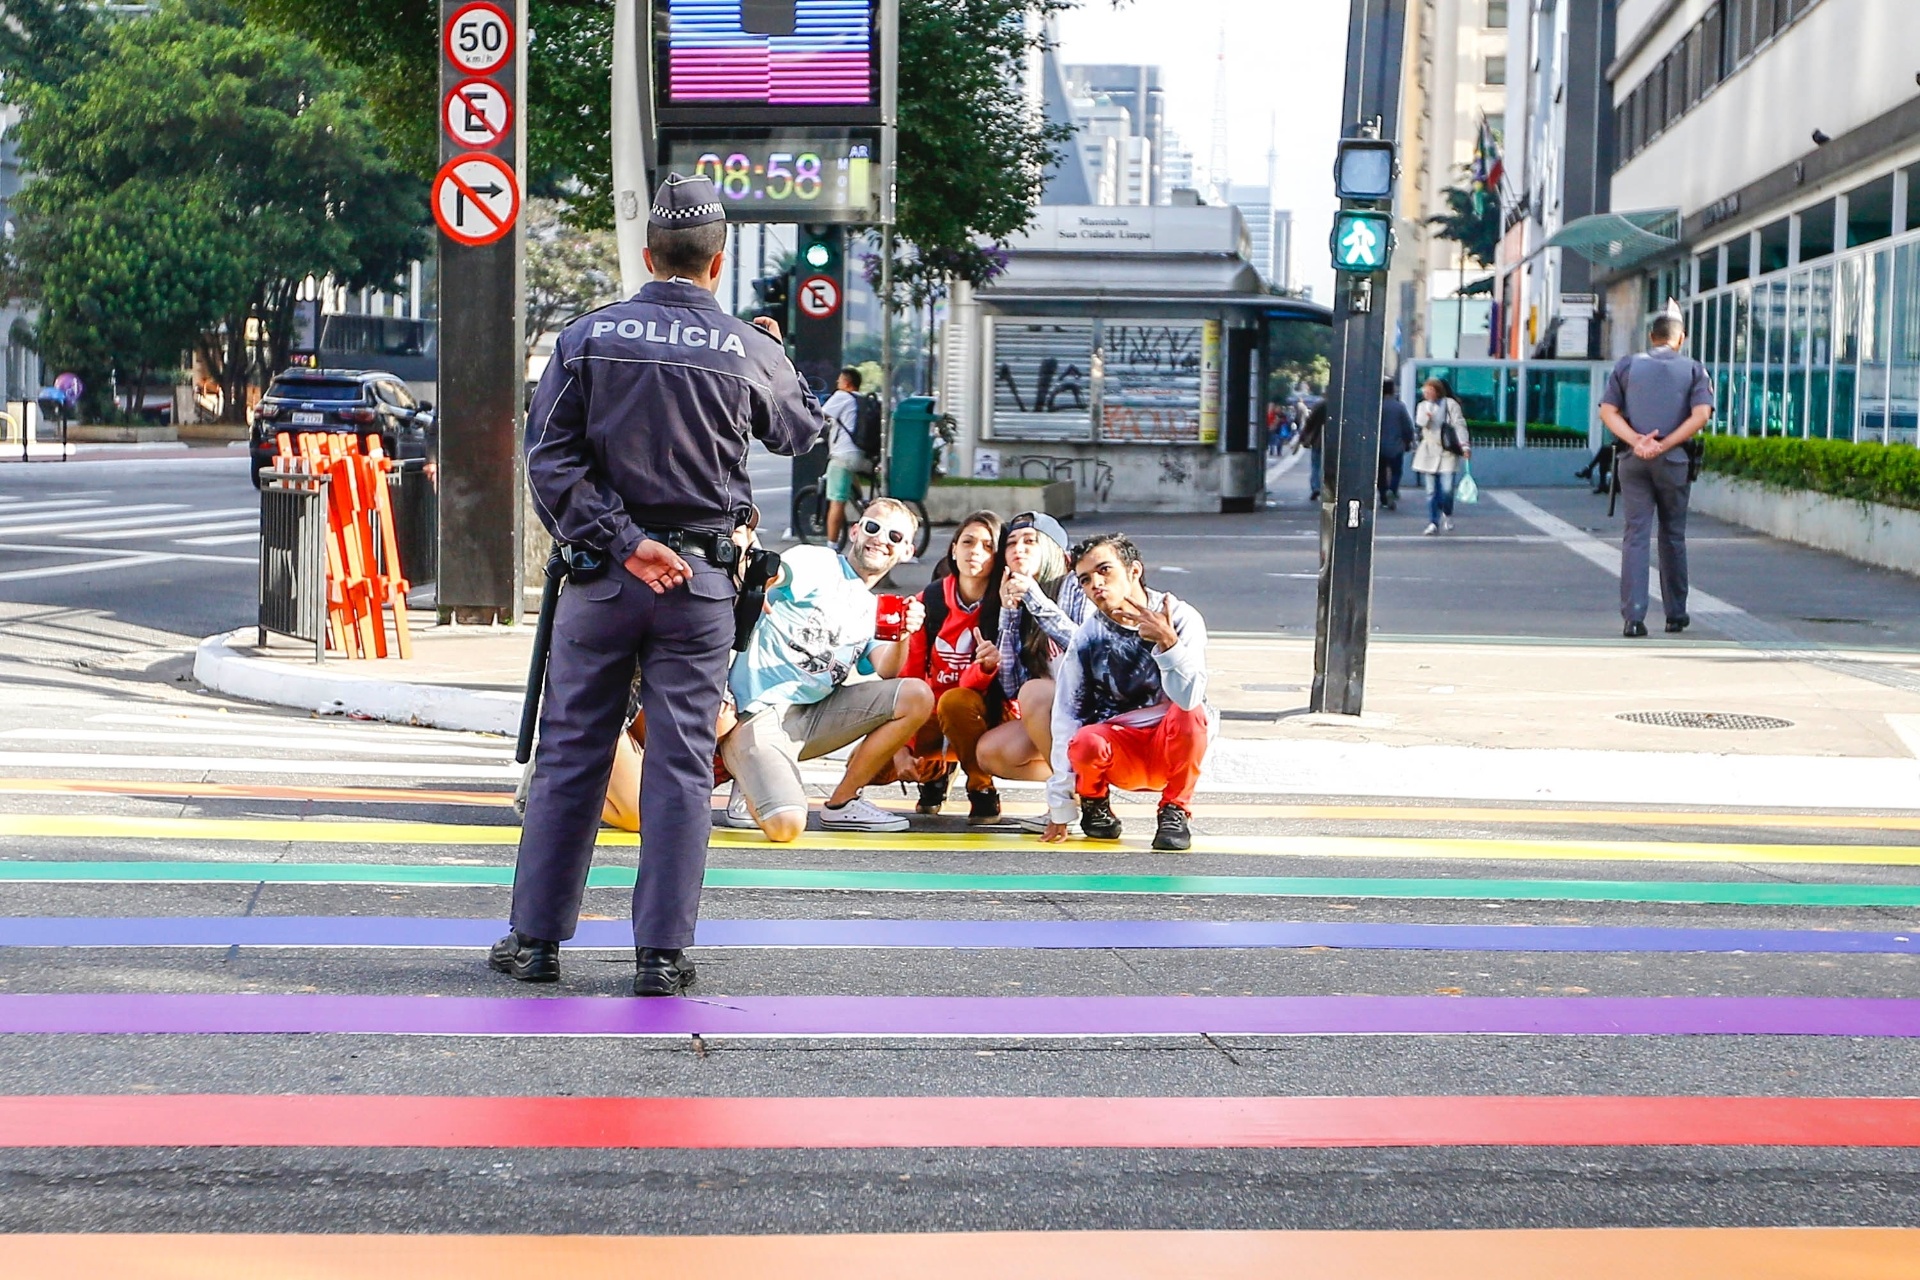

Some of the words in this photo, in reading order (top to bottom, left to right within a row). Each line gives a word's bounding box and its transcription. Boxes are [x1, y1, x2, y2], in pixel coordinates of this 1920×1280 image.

[459, 21, 501, 52] 50
[465, 55, 493, 63] km/h
[465, 92, 488, 131] E
[849, 145, 869, 158] AR
[695, 153, 822, 200] 08:58
[1059, 230, 1077, 239] Sua
[1080, 230, 1116, 239] Cidade
[1119, 230, 1151, 241] Limpa
[812, 286, 826, 308] E
[592, 320, 746, 358] POLÍCIA
[936, 670, 959, 684] adi
